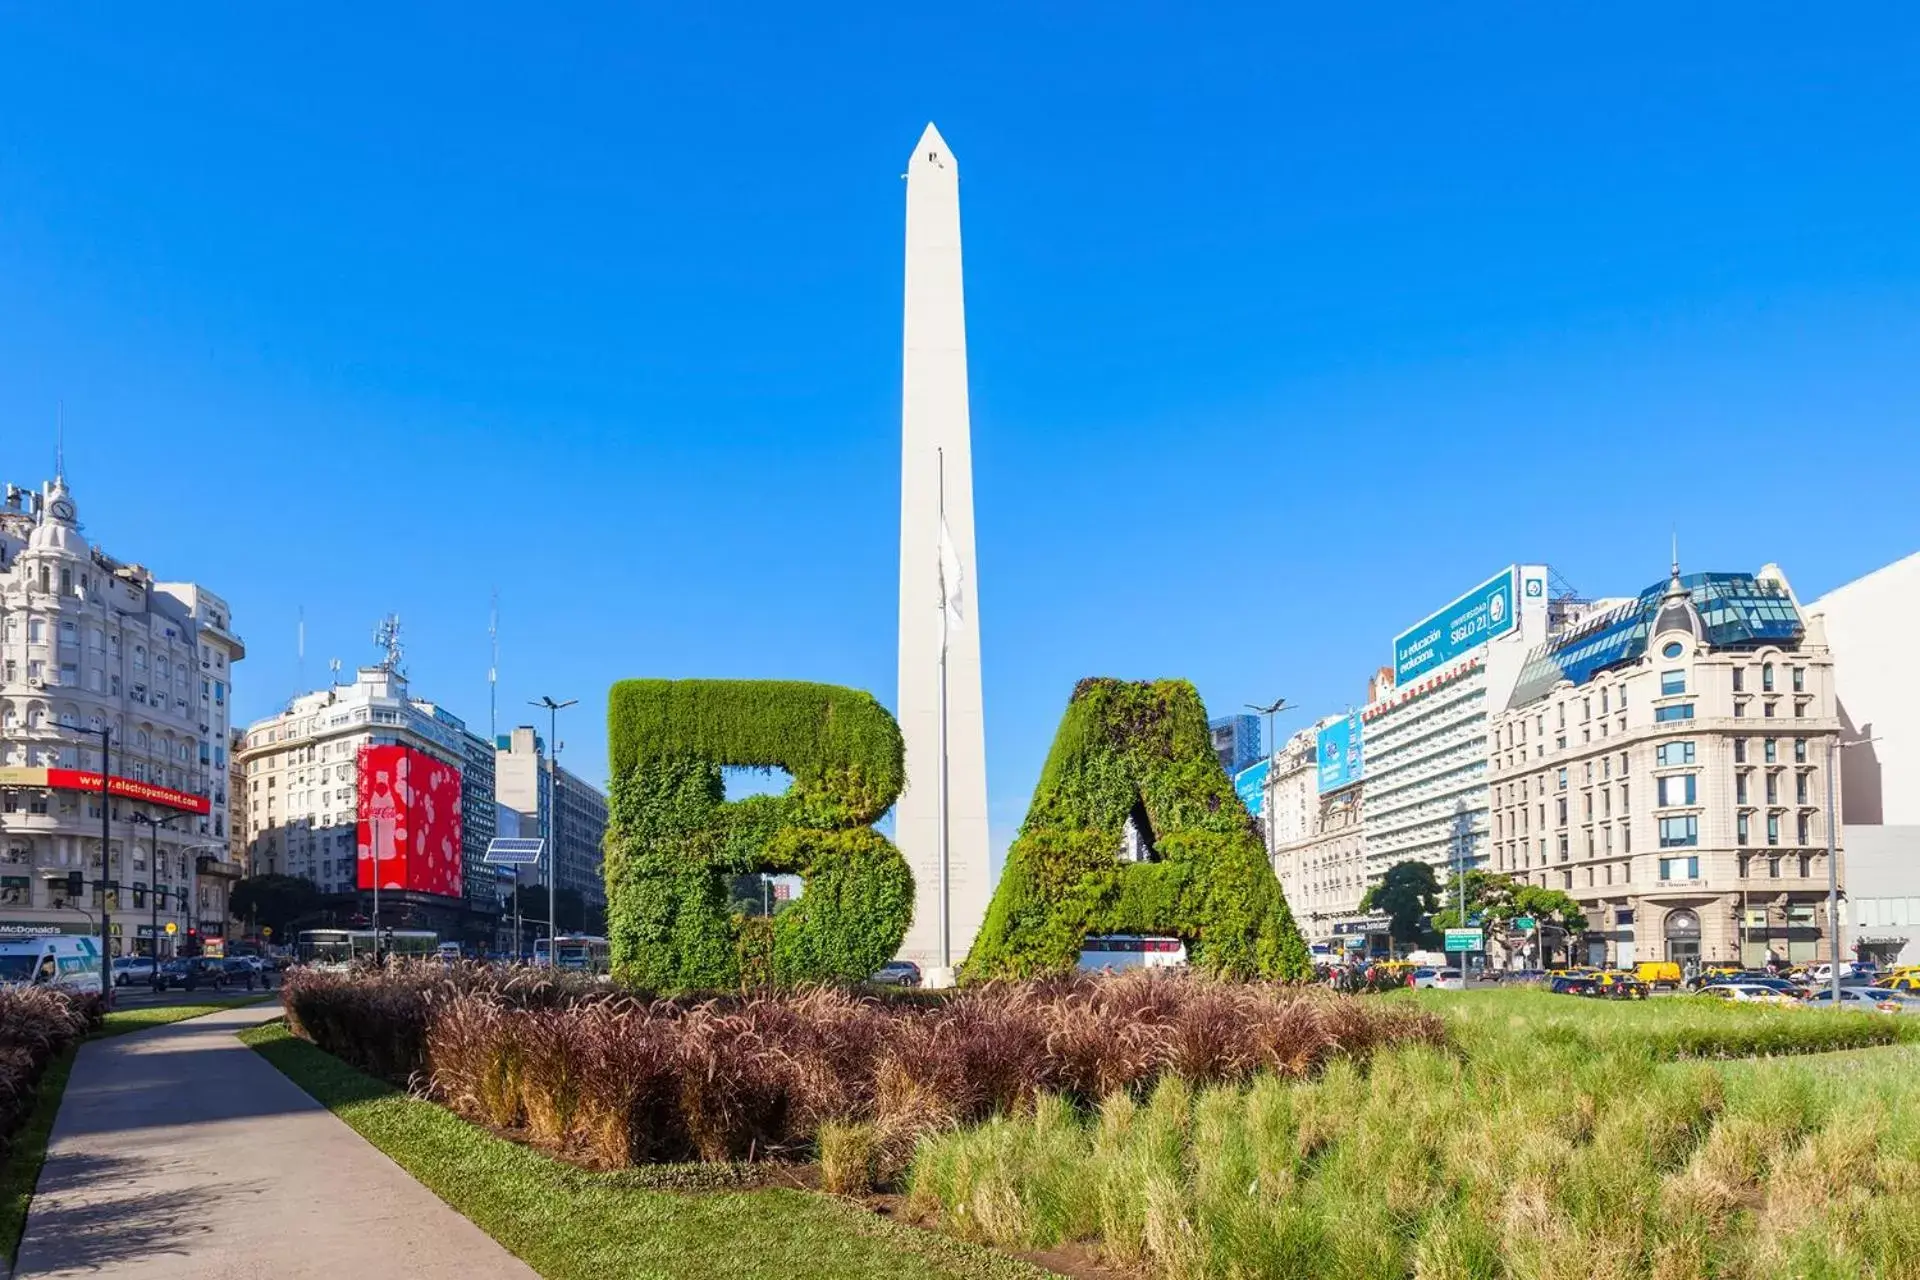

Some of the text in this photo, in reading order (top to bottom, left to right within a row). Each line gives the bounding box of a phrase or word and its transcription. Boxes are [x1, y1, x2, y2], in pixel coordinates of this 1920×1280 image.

[1399, 628, 1441, 661] La educación
[1450, 613, 1487, 646] SIGLO 21
